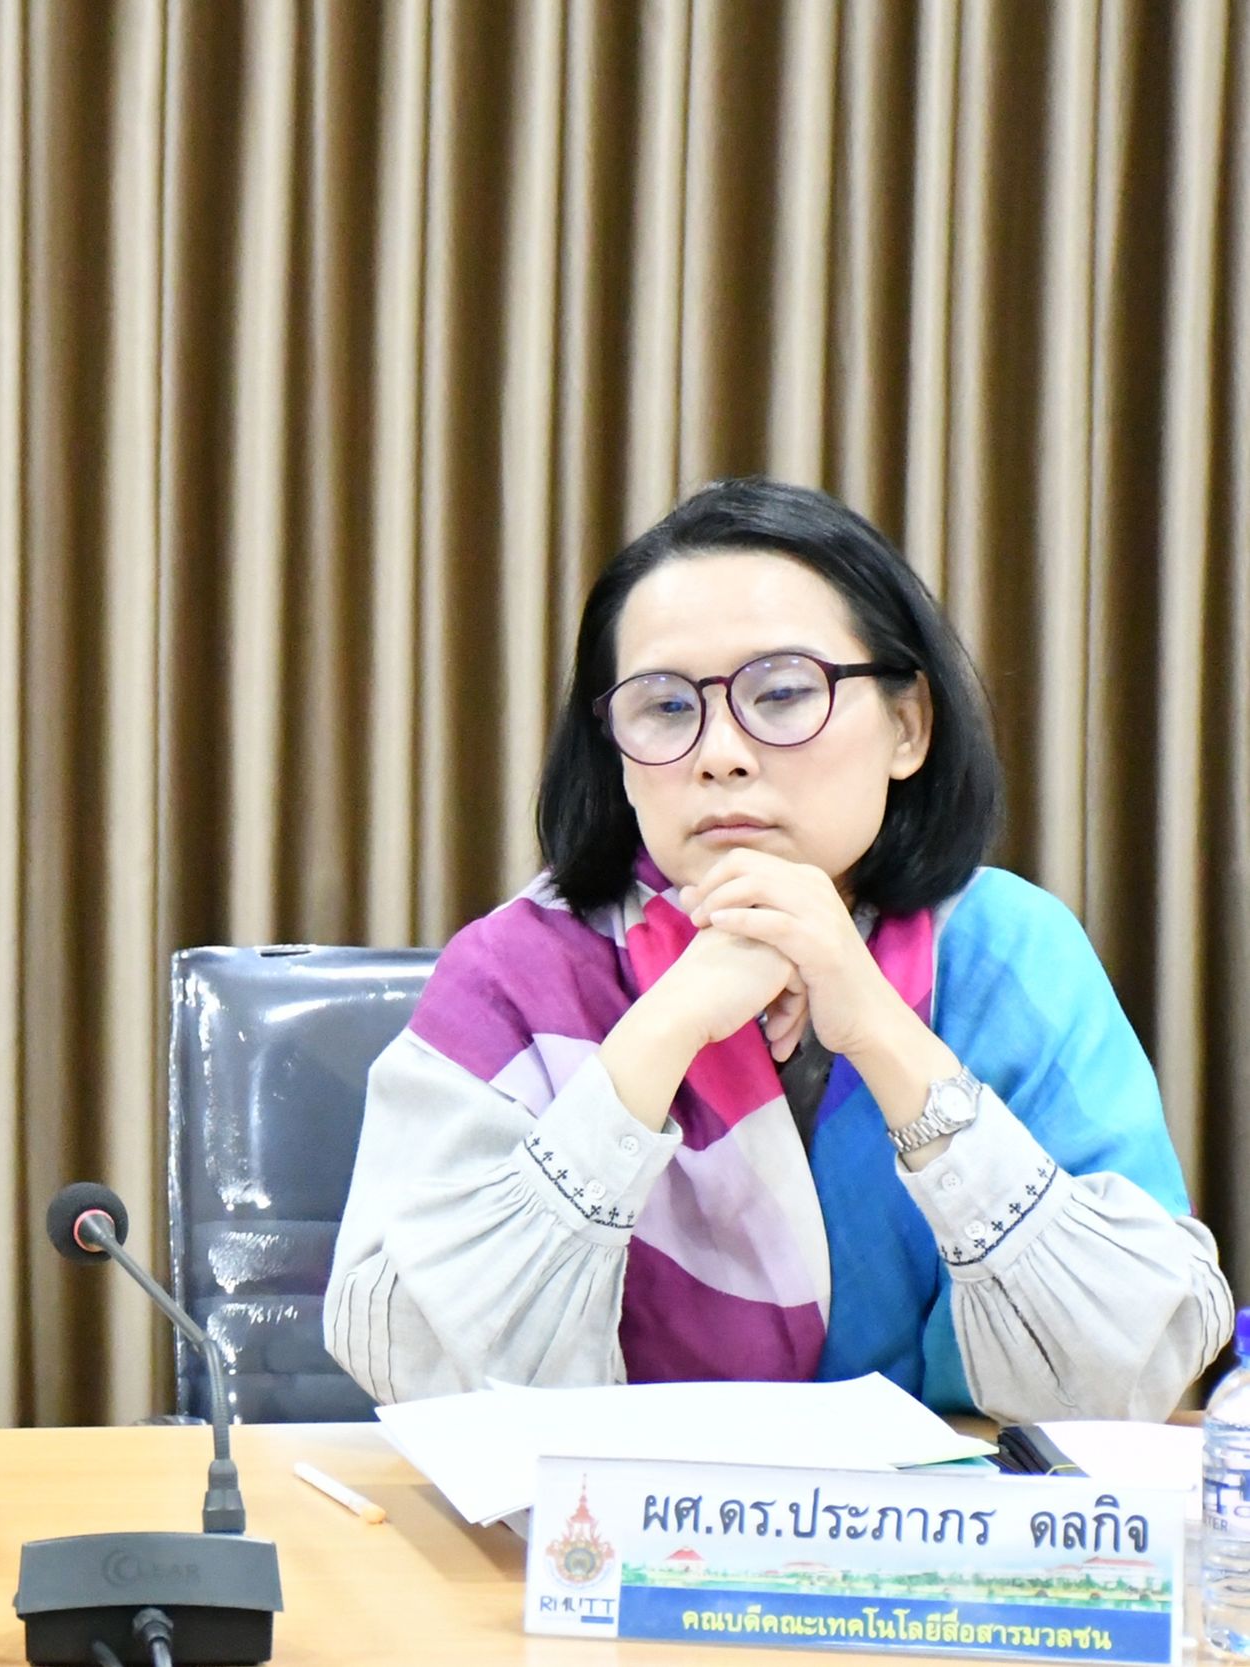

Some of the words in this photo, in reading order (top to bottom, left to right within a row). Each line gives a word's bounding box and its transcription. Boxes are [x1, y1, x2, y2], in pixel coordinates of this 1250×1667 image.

[642, 1487, 997, 1546] ผศ.ดร.ประภาภร
[1030, 1494, 1149, 1553] ดลกิจ
